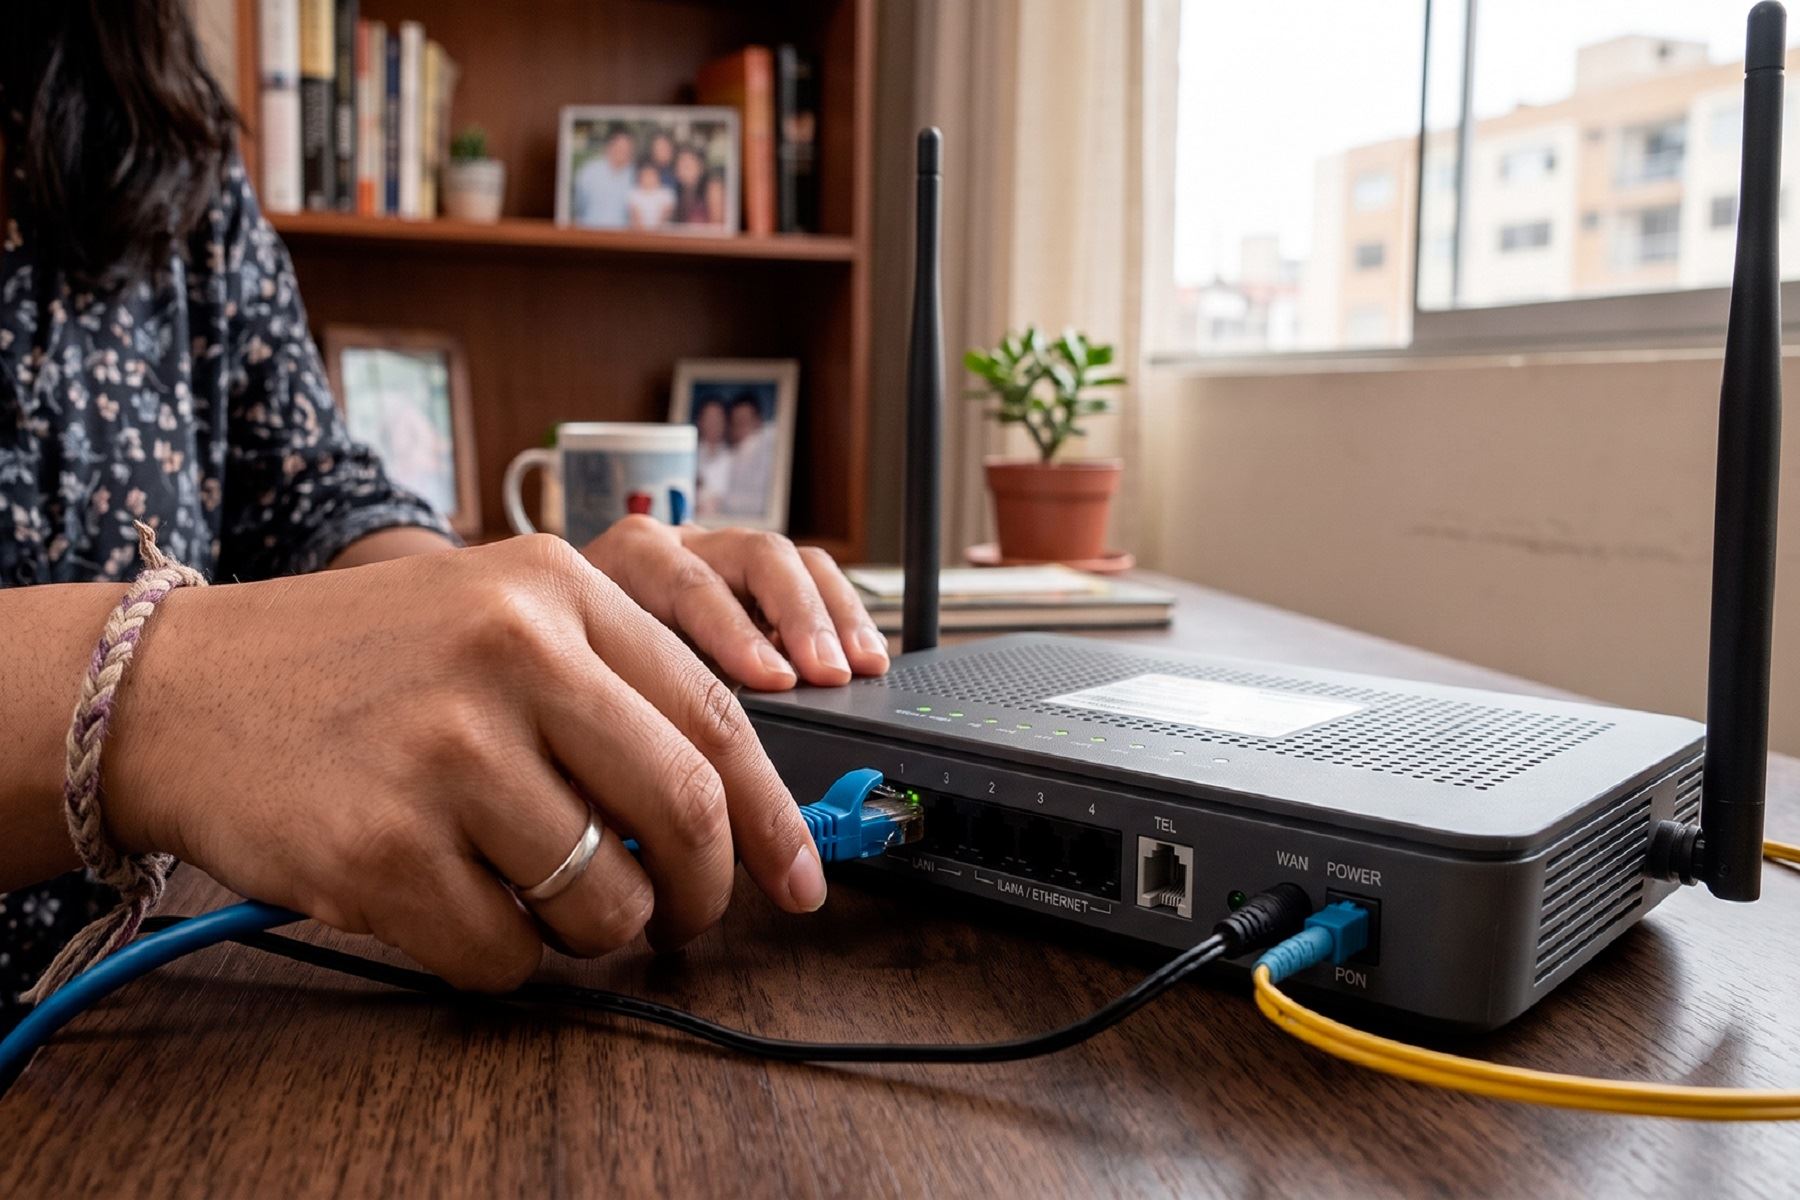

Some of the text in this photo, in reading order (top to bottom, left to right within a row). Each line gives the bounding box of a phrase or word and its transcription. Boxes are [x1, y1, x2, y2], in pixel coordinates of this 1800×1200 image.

[943, 772, 950, 784] 3
[988, 781, 996, 794] 2
[1037, 791, 1045, 804] 3
[1088, 803, 1096, 815] 4
[1154, 816, 1177, 834] TEL
[1276, 850, 1309, 871] WAN
[1326, 862, 1382, 887] POWER
[1032, 888, 1089, 913] ETHERNET
[1335, 967, 1367, 989] PON
